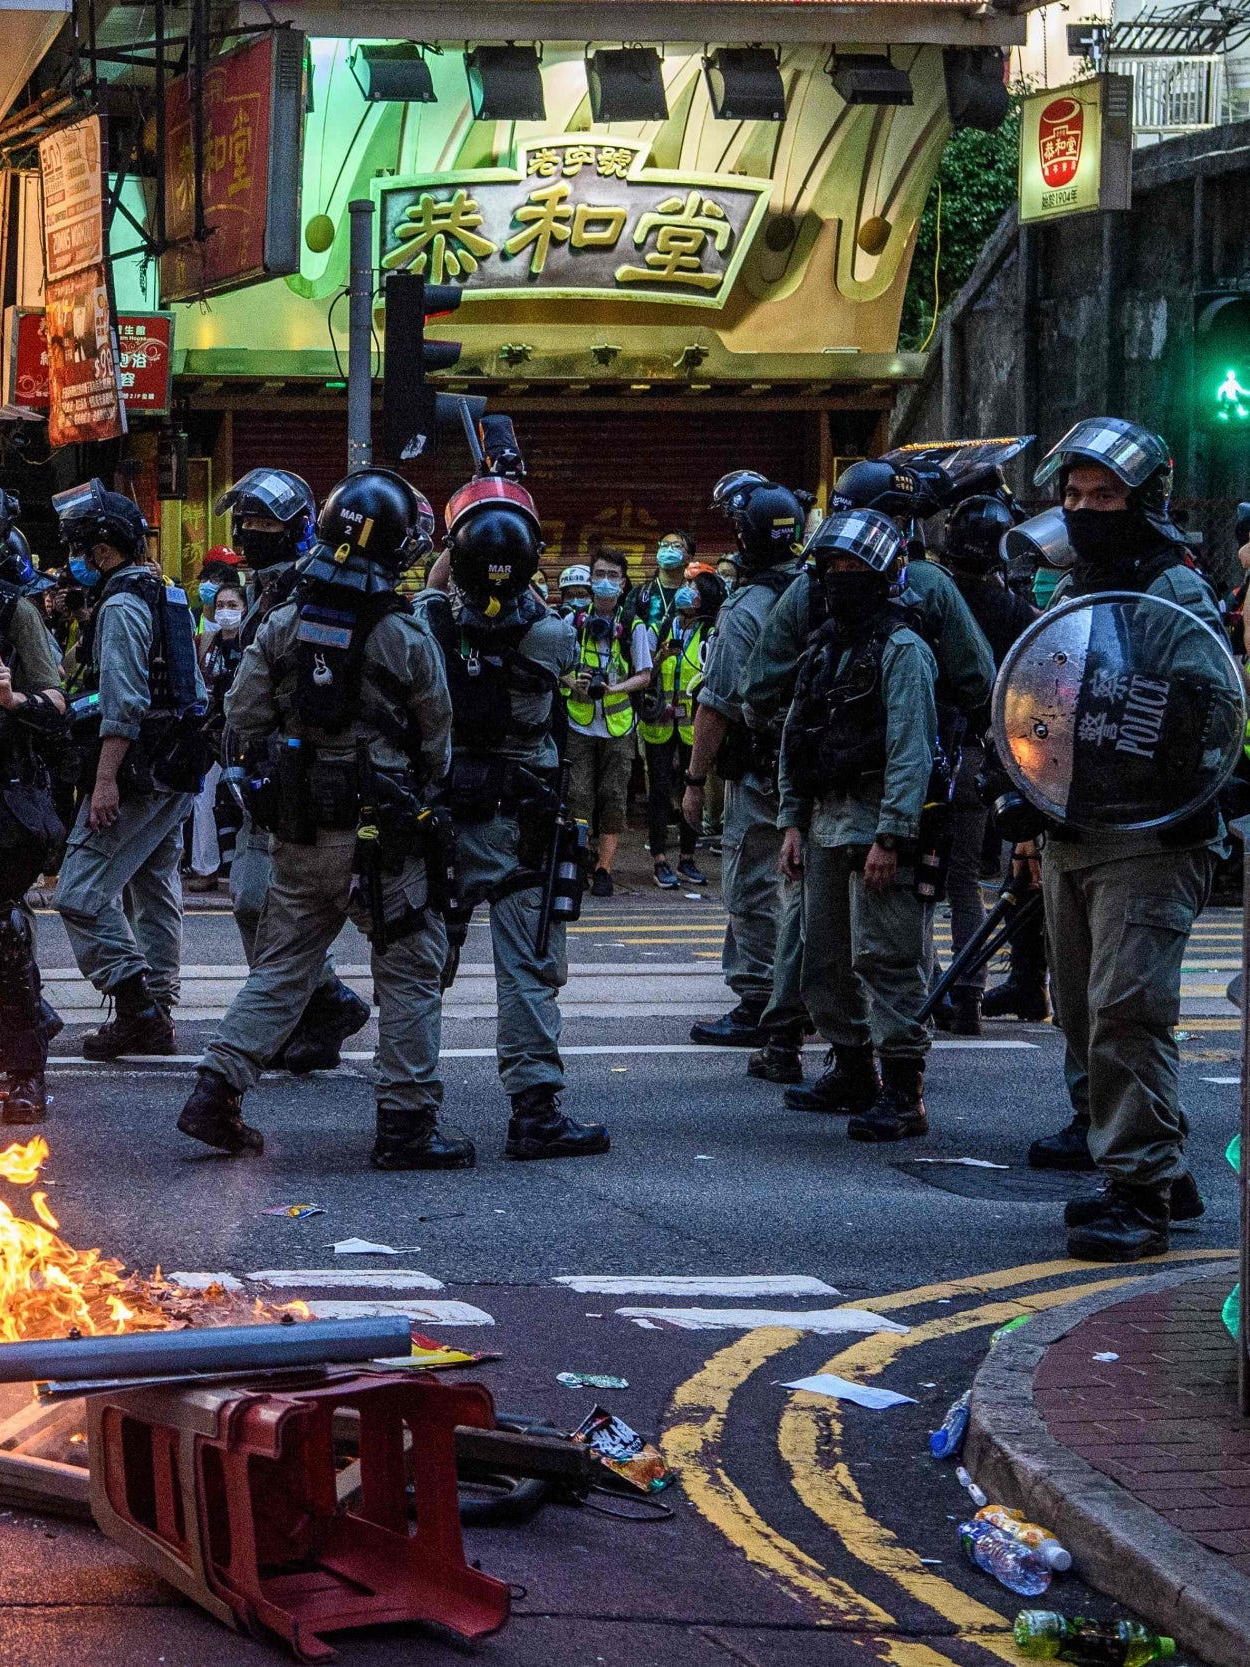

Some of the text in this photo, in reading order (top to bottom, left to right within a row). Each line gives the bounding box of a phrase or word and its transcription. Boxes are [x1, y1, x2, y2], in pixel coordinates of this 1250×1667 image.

[528, 146, 632, 177] 老字號
[1044, 136, 1076, 160] 恭和堂
[382, 181, 731, 289] 恭和堂
[340, 508, 363, 524] MAR
[344, 525, 353, 535] 2
[488, 564, 512, 573] MAR
[1078, 670, 1129, 747] 警察
[1115, 674, 1170, 759] POLICE
